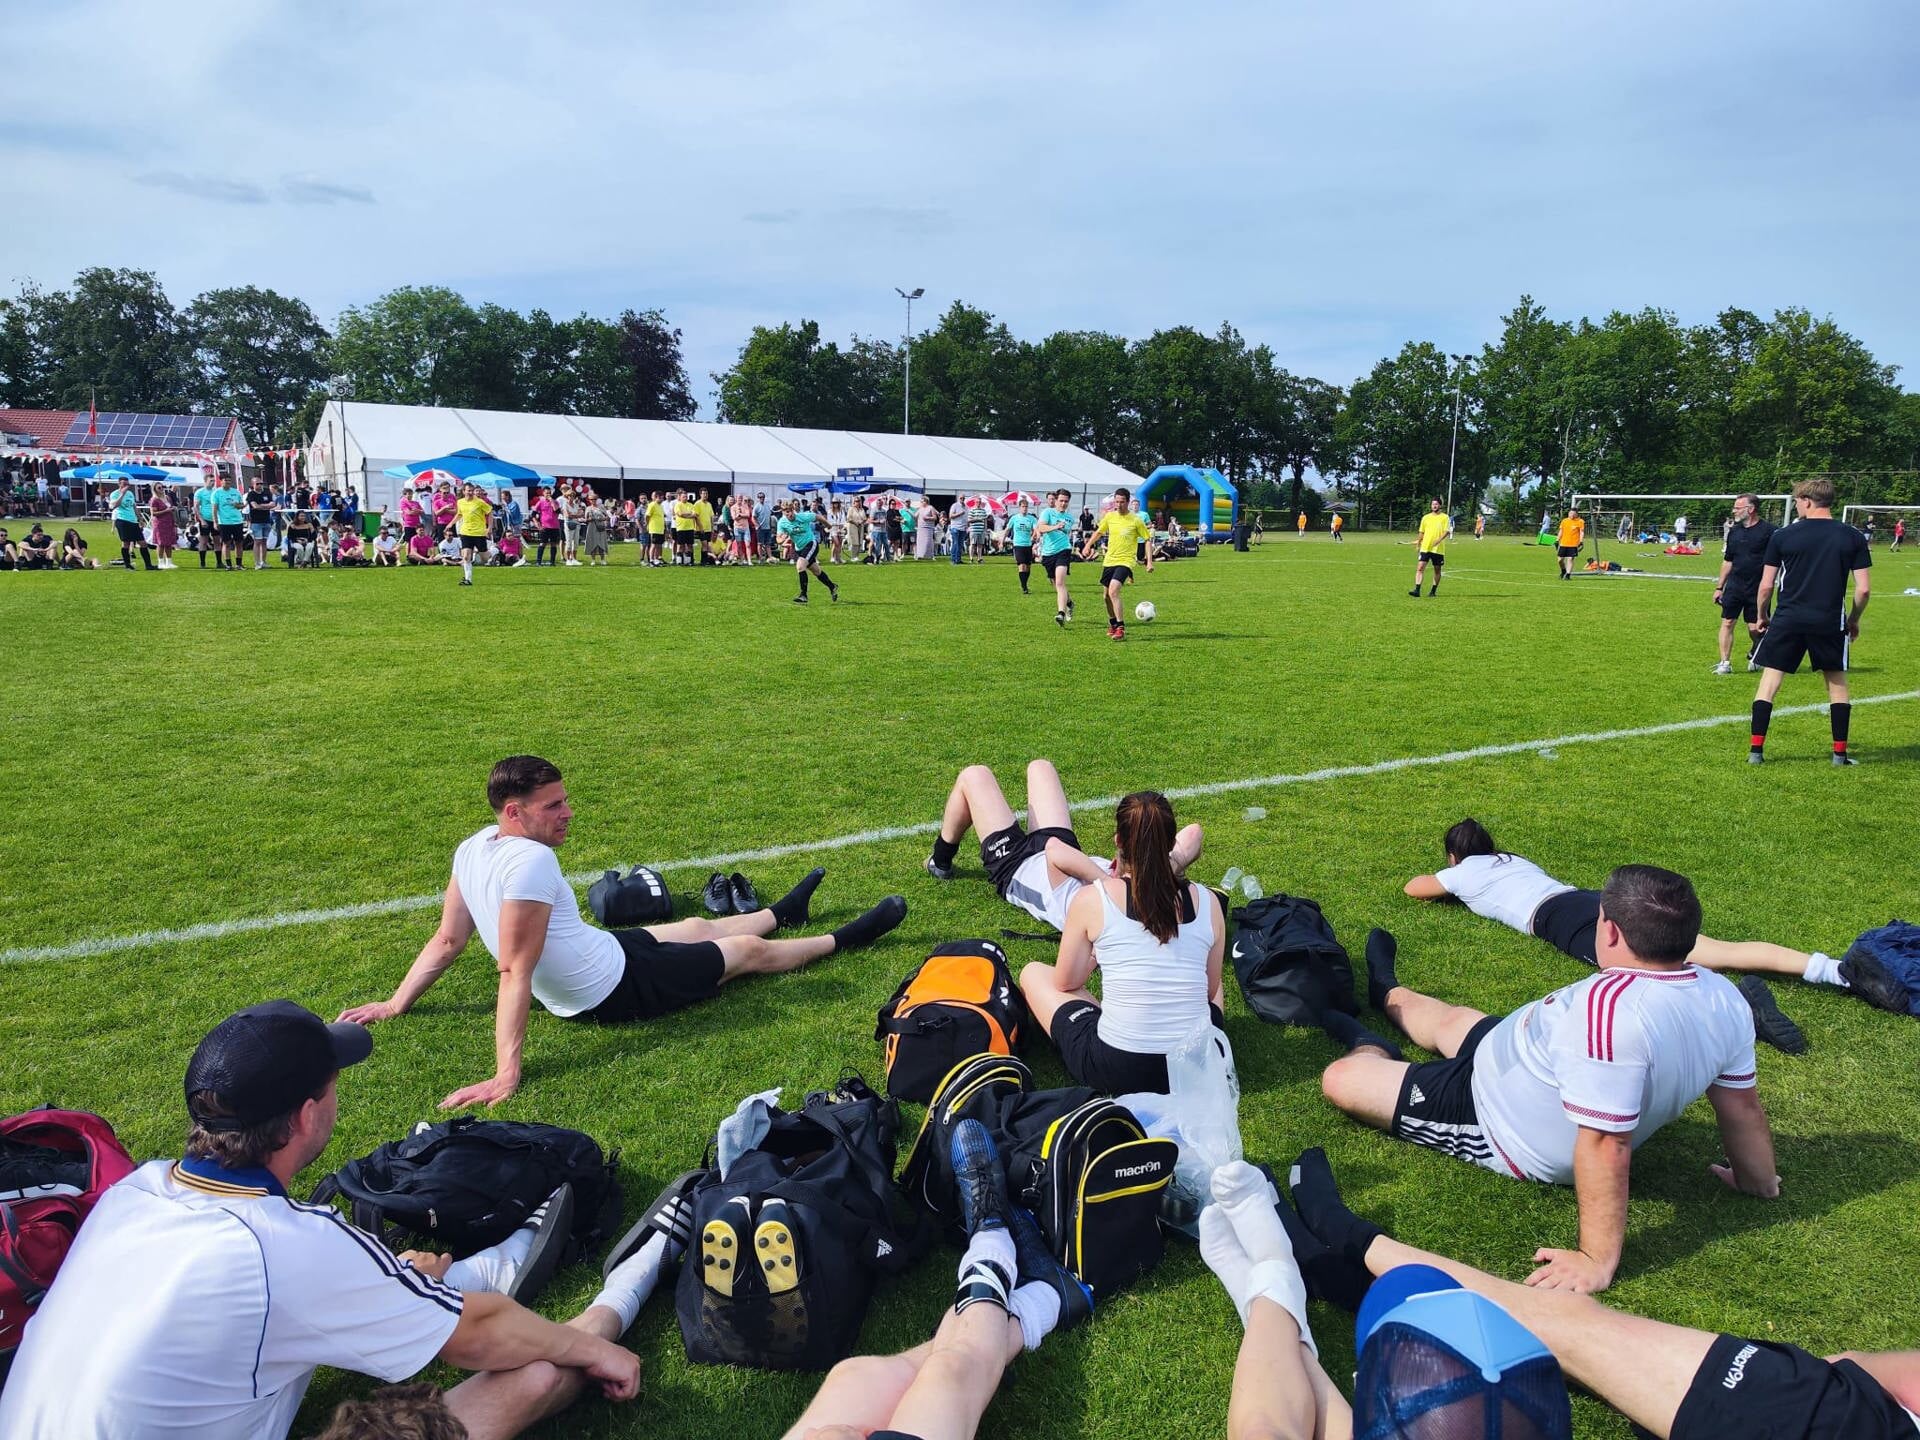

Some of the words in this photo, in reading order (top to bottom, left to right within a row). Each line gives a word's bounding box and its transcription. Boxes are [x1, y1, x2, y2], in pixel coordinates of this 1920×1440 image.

[995, 845, 1010, 858] 76
[1115, 1161, 1161, 1178] macron
[1722, 1344, 1759, 1389] macron
